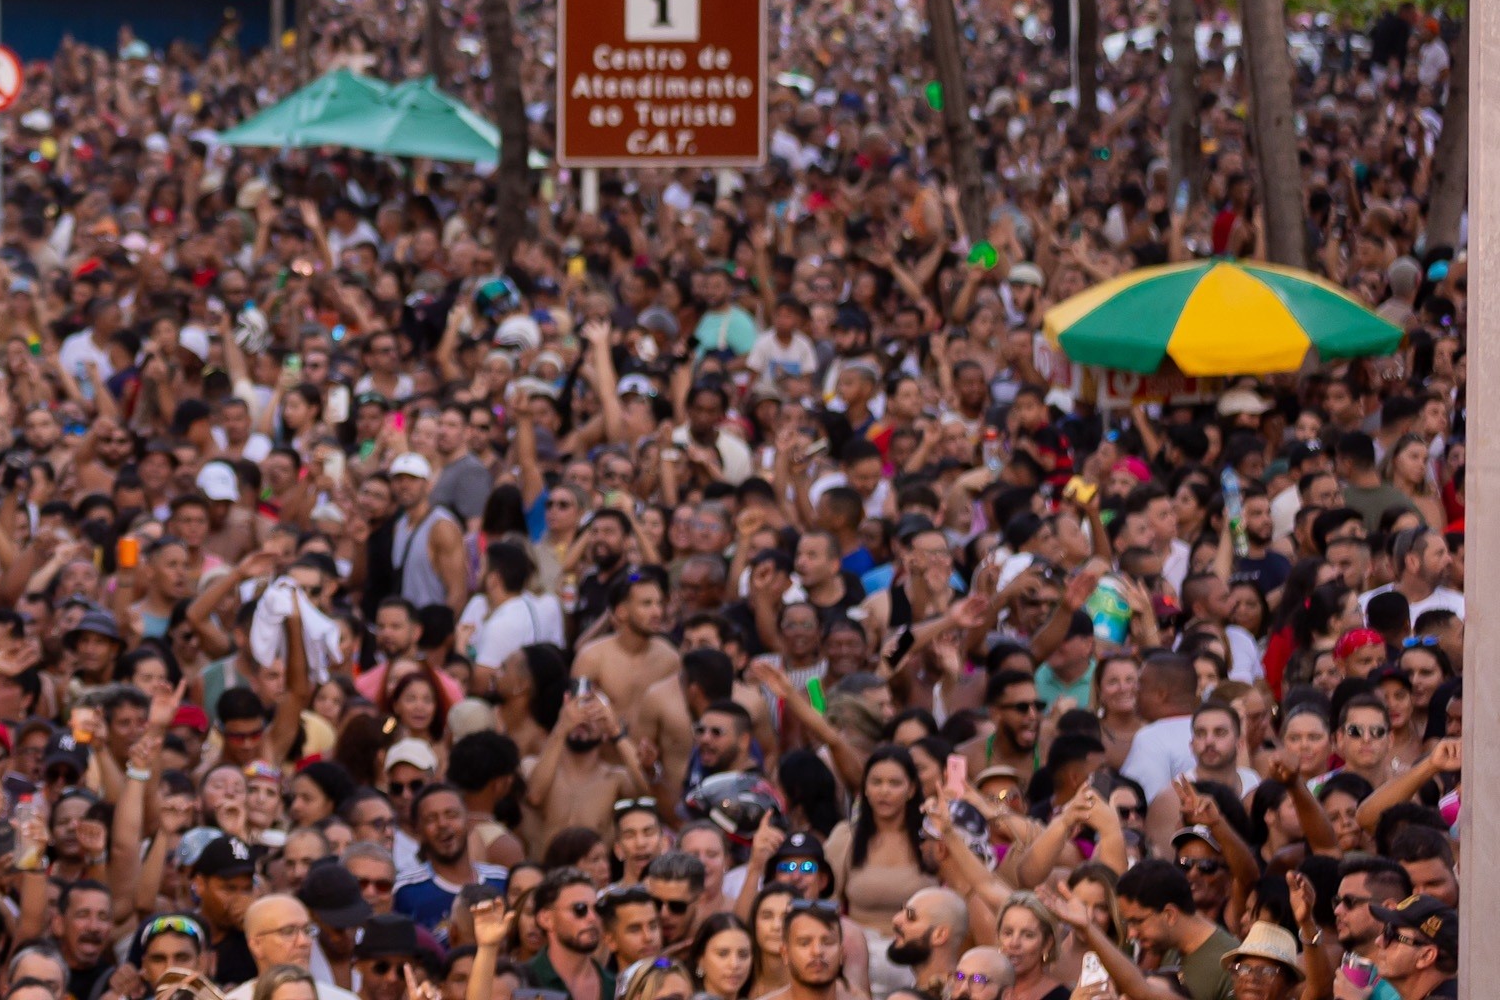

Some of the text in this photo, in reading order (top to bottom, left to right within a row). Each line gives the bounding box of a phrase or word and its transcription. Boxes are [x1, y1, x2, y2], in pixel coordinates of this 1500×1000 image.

[593, 44, 732, 71] Centro de
[572, 72, 753, 99] Atendimento
[588, 101, 736, 127] ao Turista
